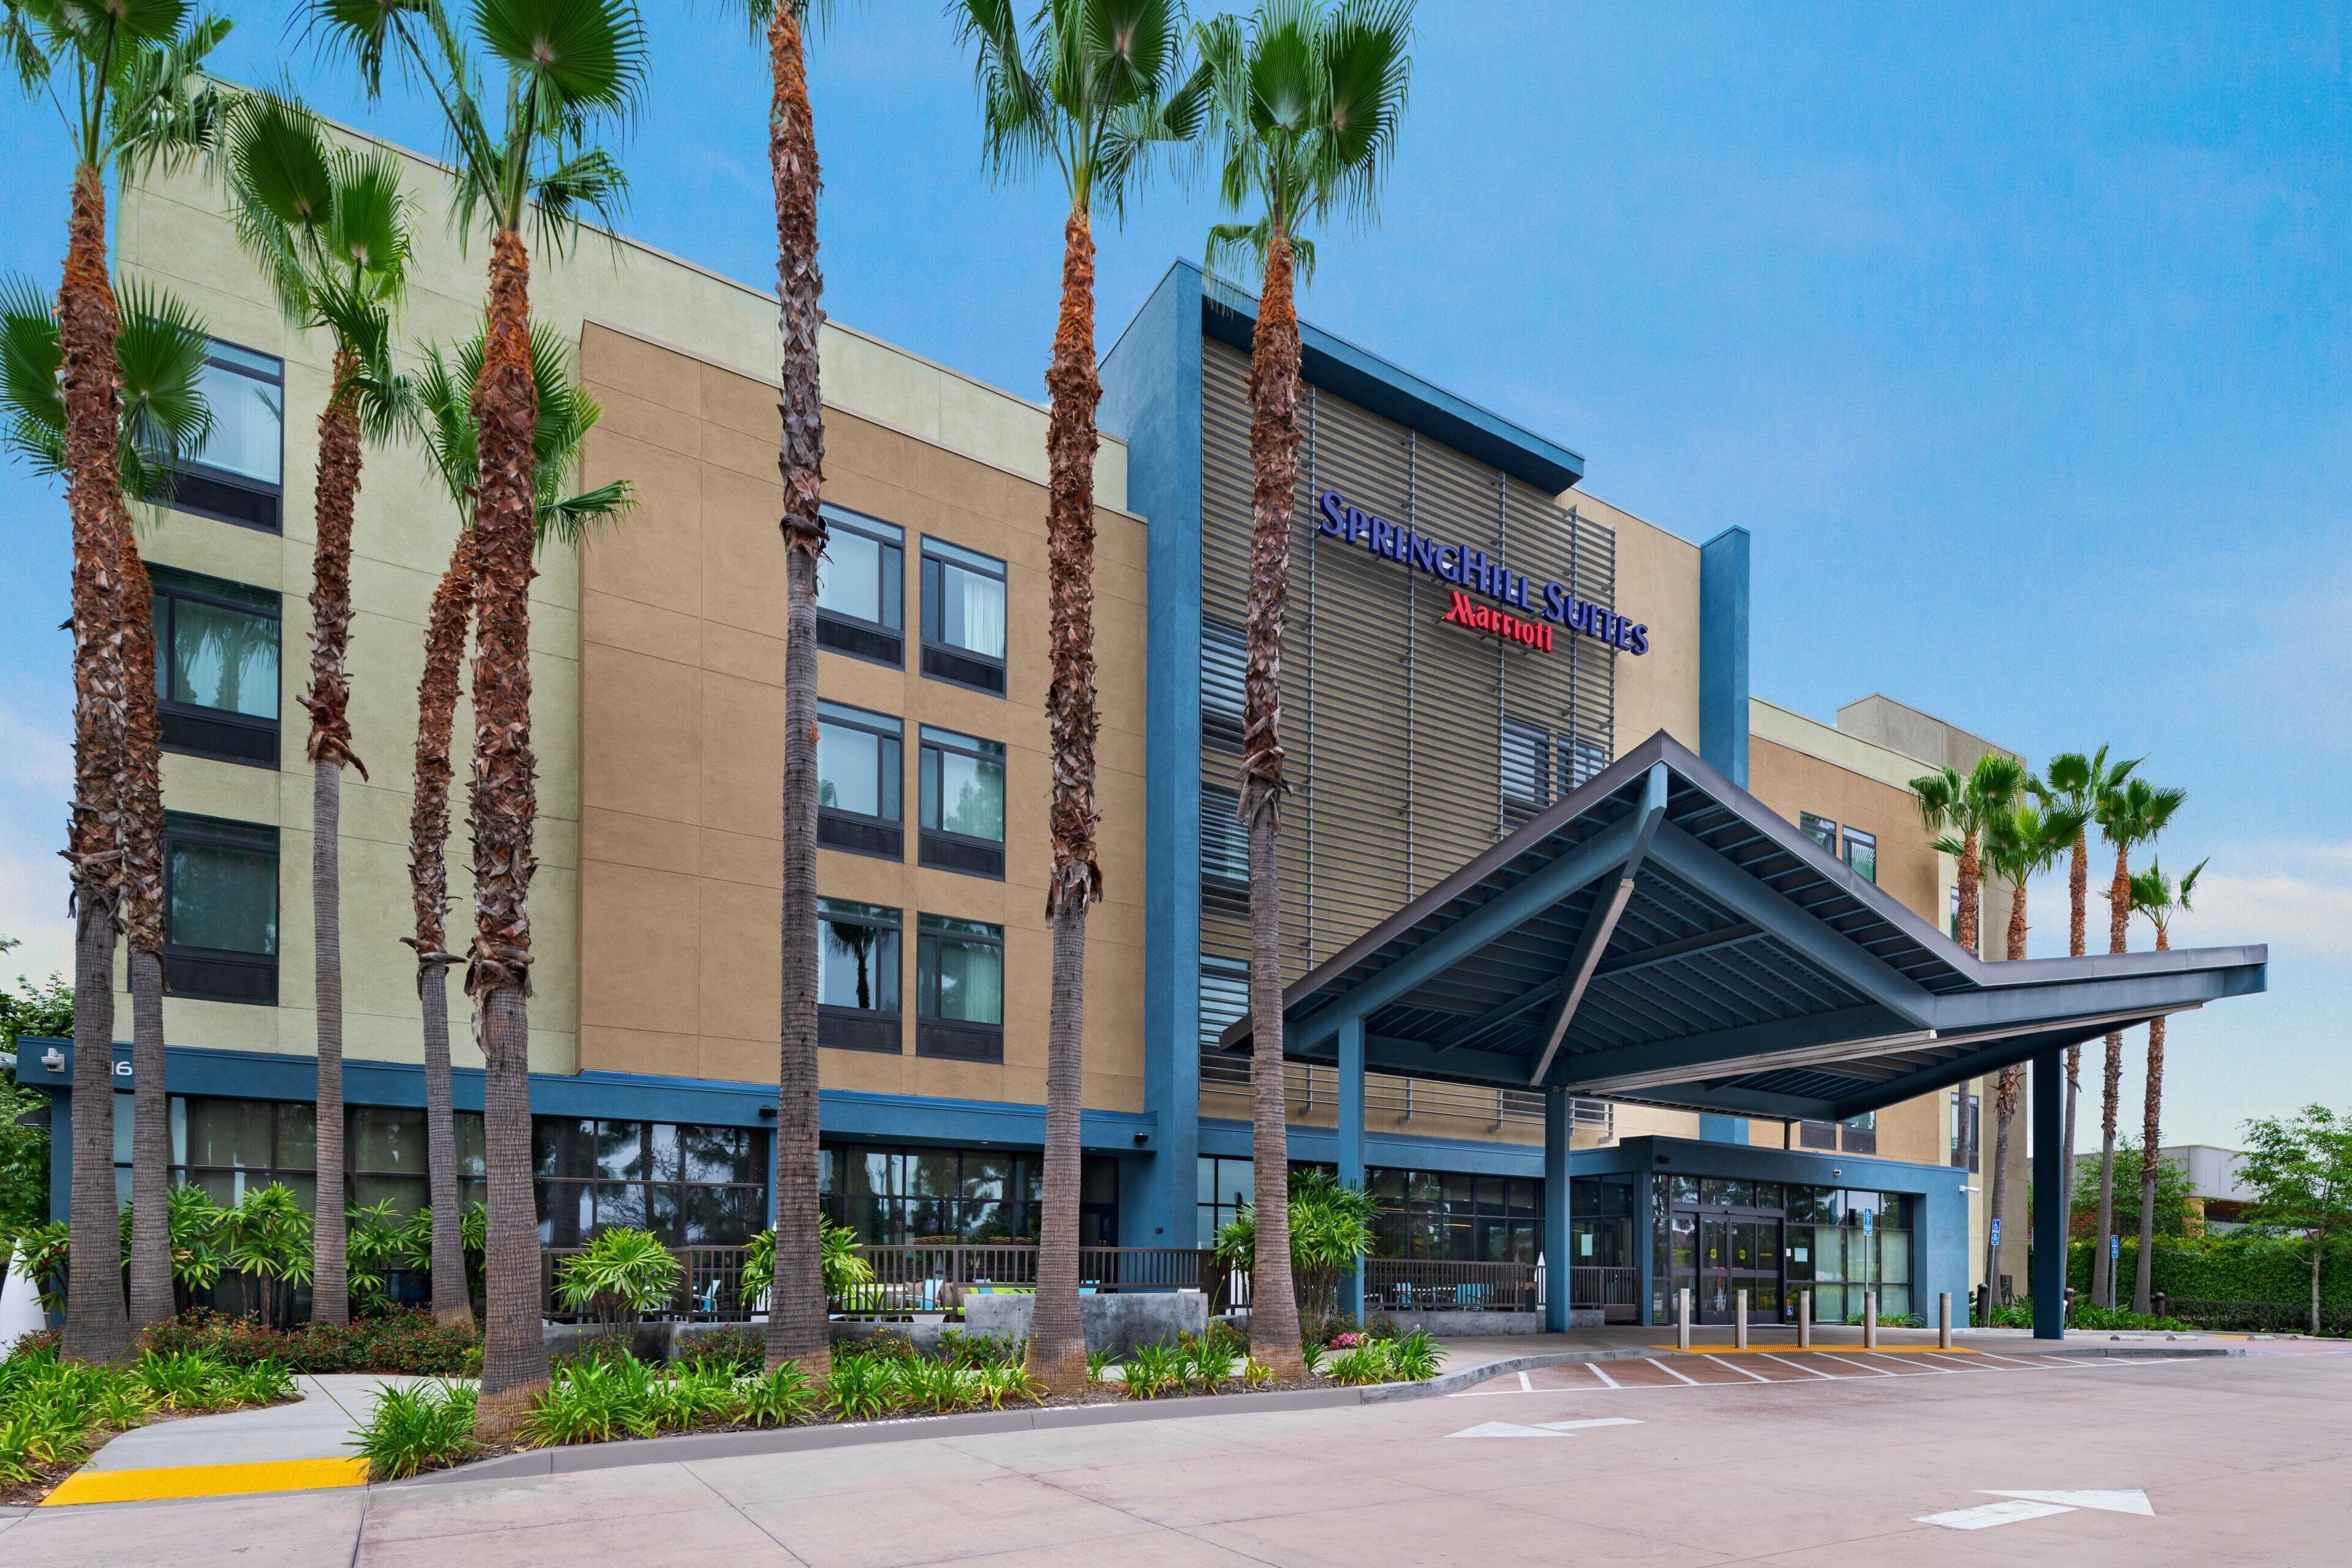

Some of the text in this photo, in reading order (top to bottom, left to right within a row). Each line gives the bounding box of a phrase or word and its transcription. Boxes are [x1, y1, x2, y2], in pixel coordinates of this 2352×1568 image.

[1319, 490, 1649, 656] SPRINGHILL SUITES
[1442, 590, 1553, 654] Marriott
